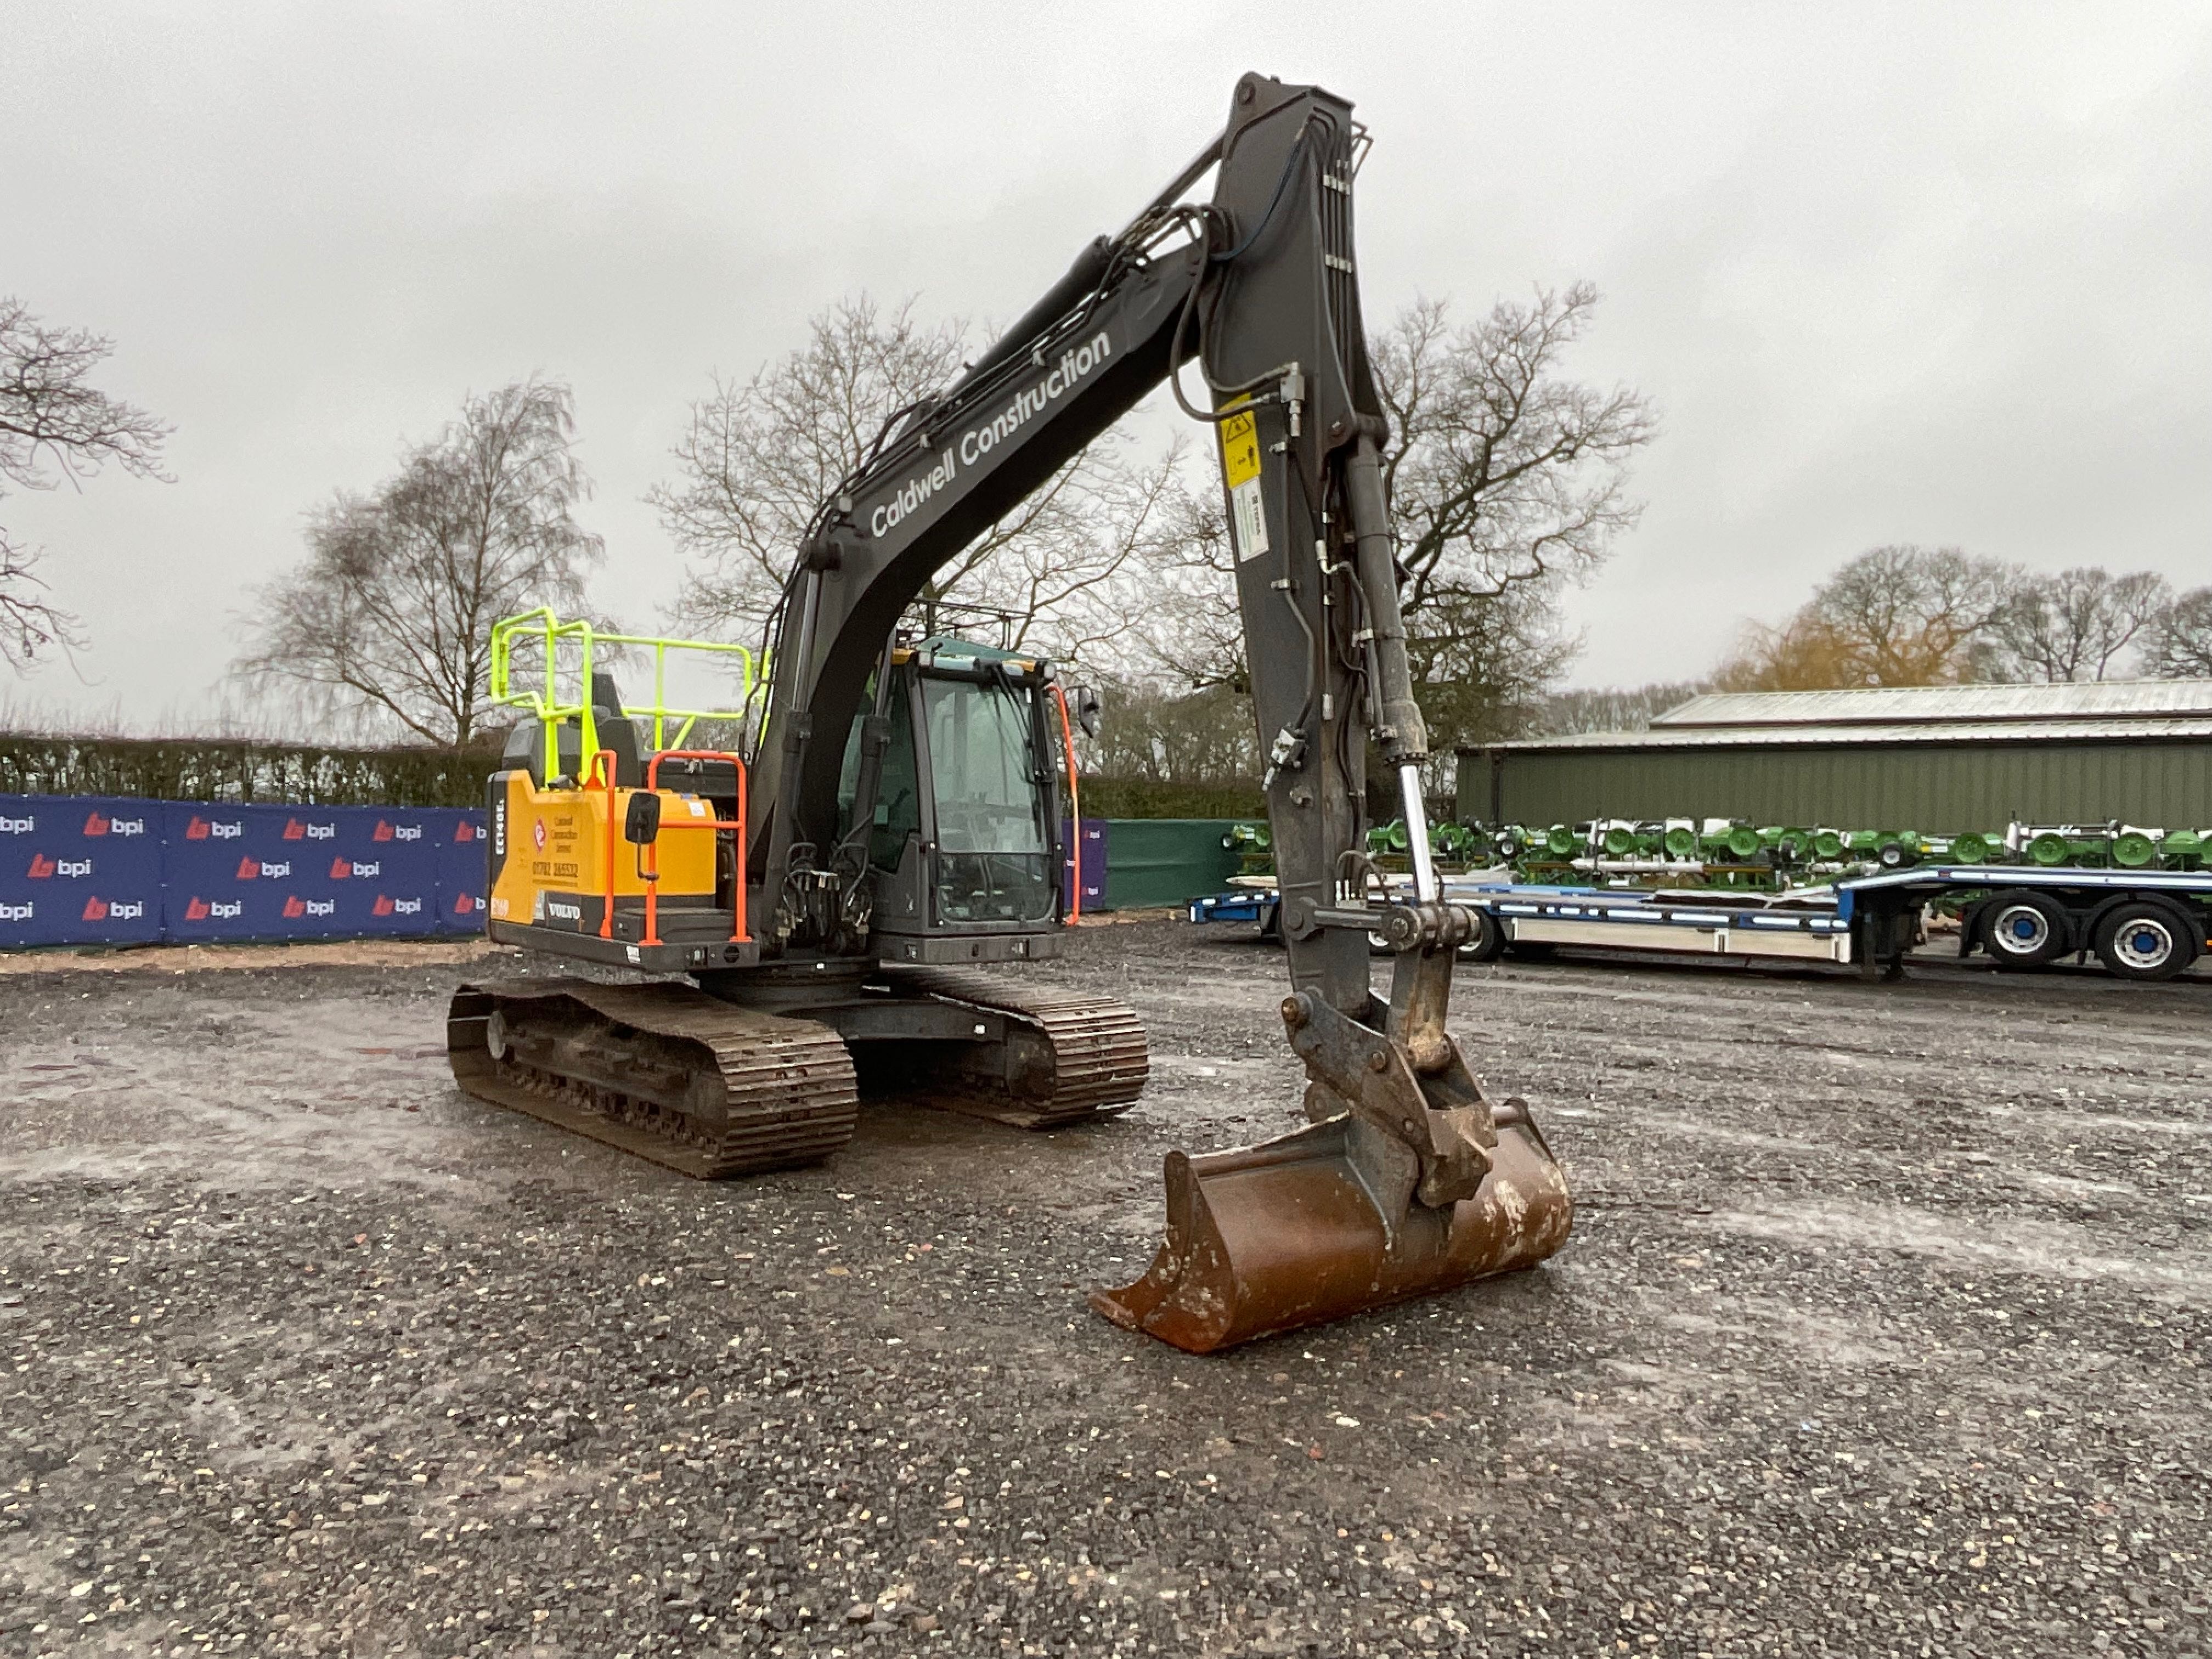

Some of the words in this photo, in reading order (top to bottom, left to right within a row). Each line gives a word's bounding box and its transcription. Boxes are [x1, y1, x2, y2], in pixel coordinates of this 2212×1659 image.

[871, 448, 956, 538] Caldwell
[960, 331, 1111, 466] Construction
[0, 815, 33, 834] bpi
[111, 816, 143, 836] bpi
[212, 821, 241, 839] bpi
[308, 823, 335, 840] bpi
[396, 824, 421, 841] bpi
[58, 859, 91, 878] bpi
[262, 861, 290, 878] bpi
[353, 861, 380, 878] bpi
[0, 901, 33, 922] bpi
[110, 901, 143, 919] bpi
[211, 900, 241, 918] bpi
[307, 899, 334, 916] bpi
[395, 898, 421, 915] bpi
[549, 902, 580, 919] VOLVO
